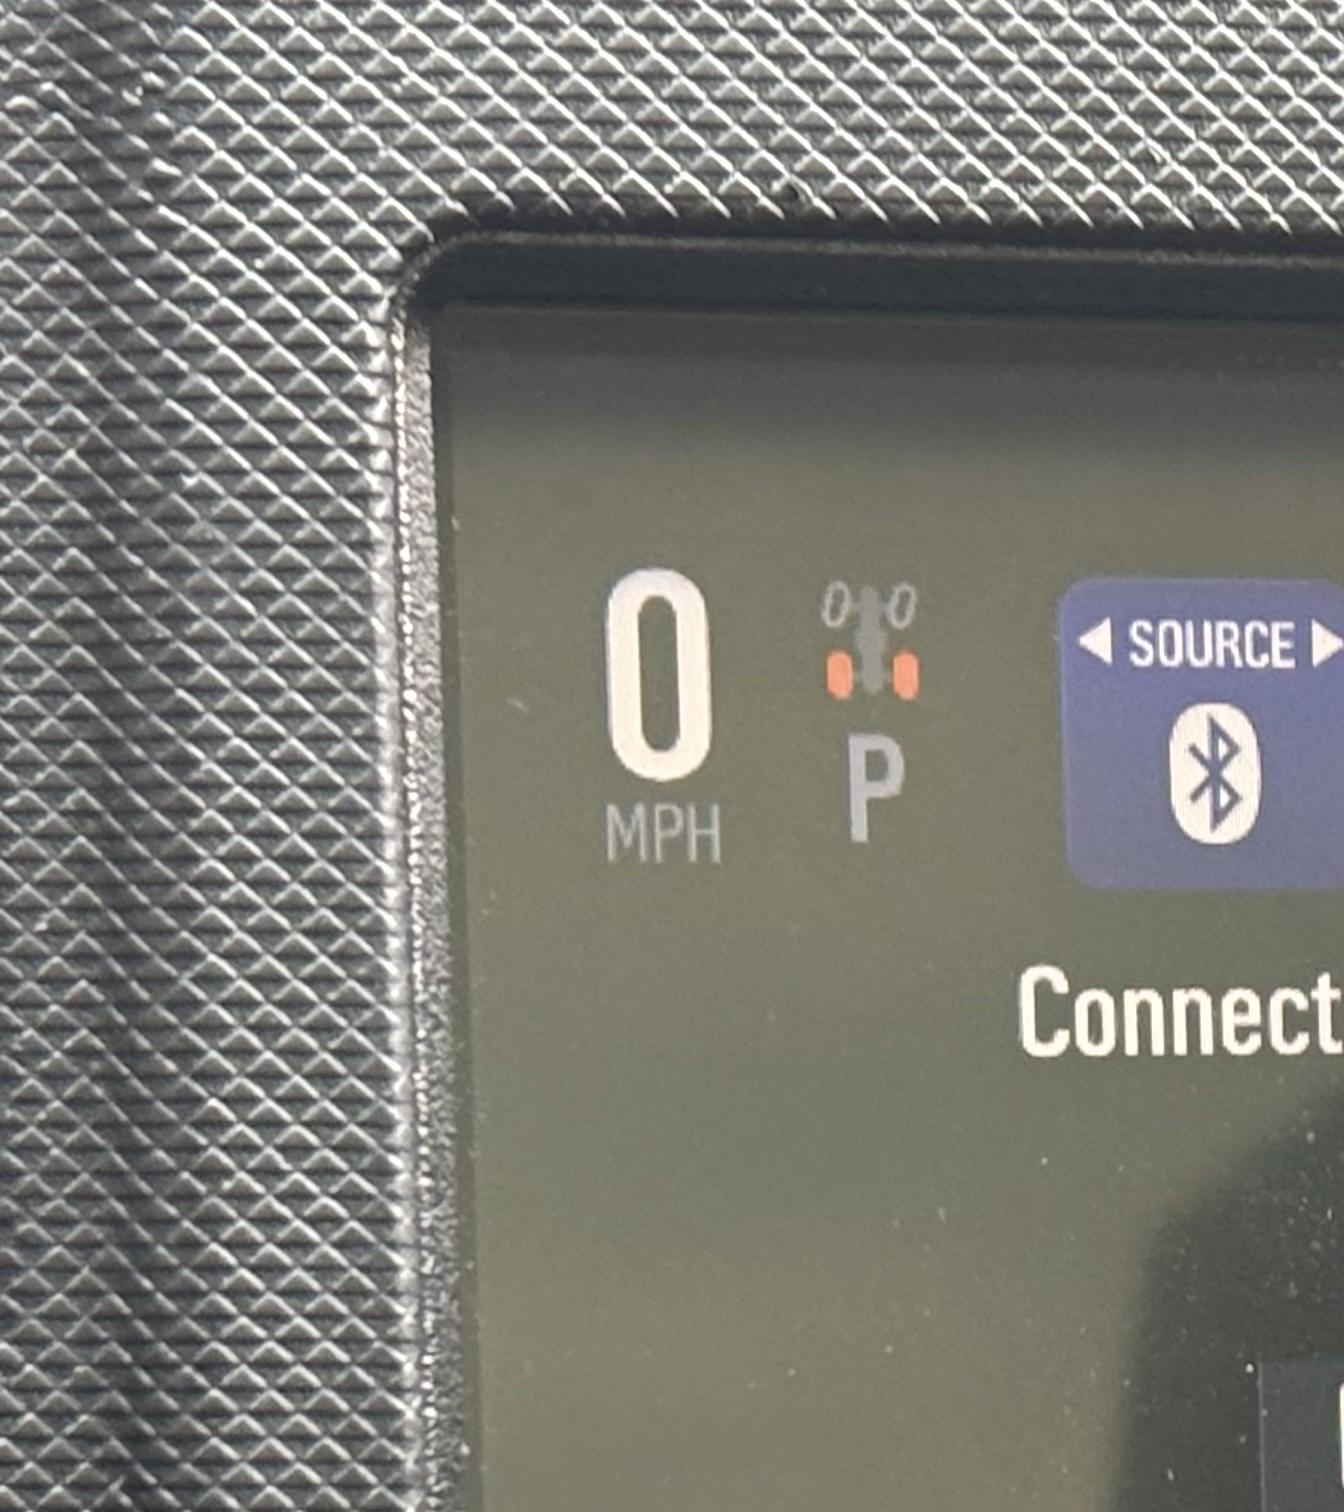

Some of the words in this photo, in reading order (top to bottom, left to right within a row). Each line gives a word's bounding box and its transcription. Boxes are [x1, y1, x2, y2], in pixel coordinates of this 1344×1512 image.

[605, 568, 712, 782] 0
[1129, 619, 1296, 669] SOURCE
[605, 802, 722, 864] MPH
[848, 732, 905, 843] P
[1019, 965, 1344, 1058] Connect
